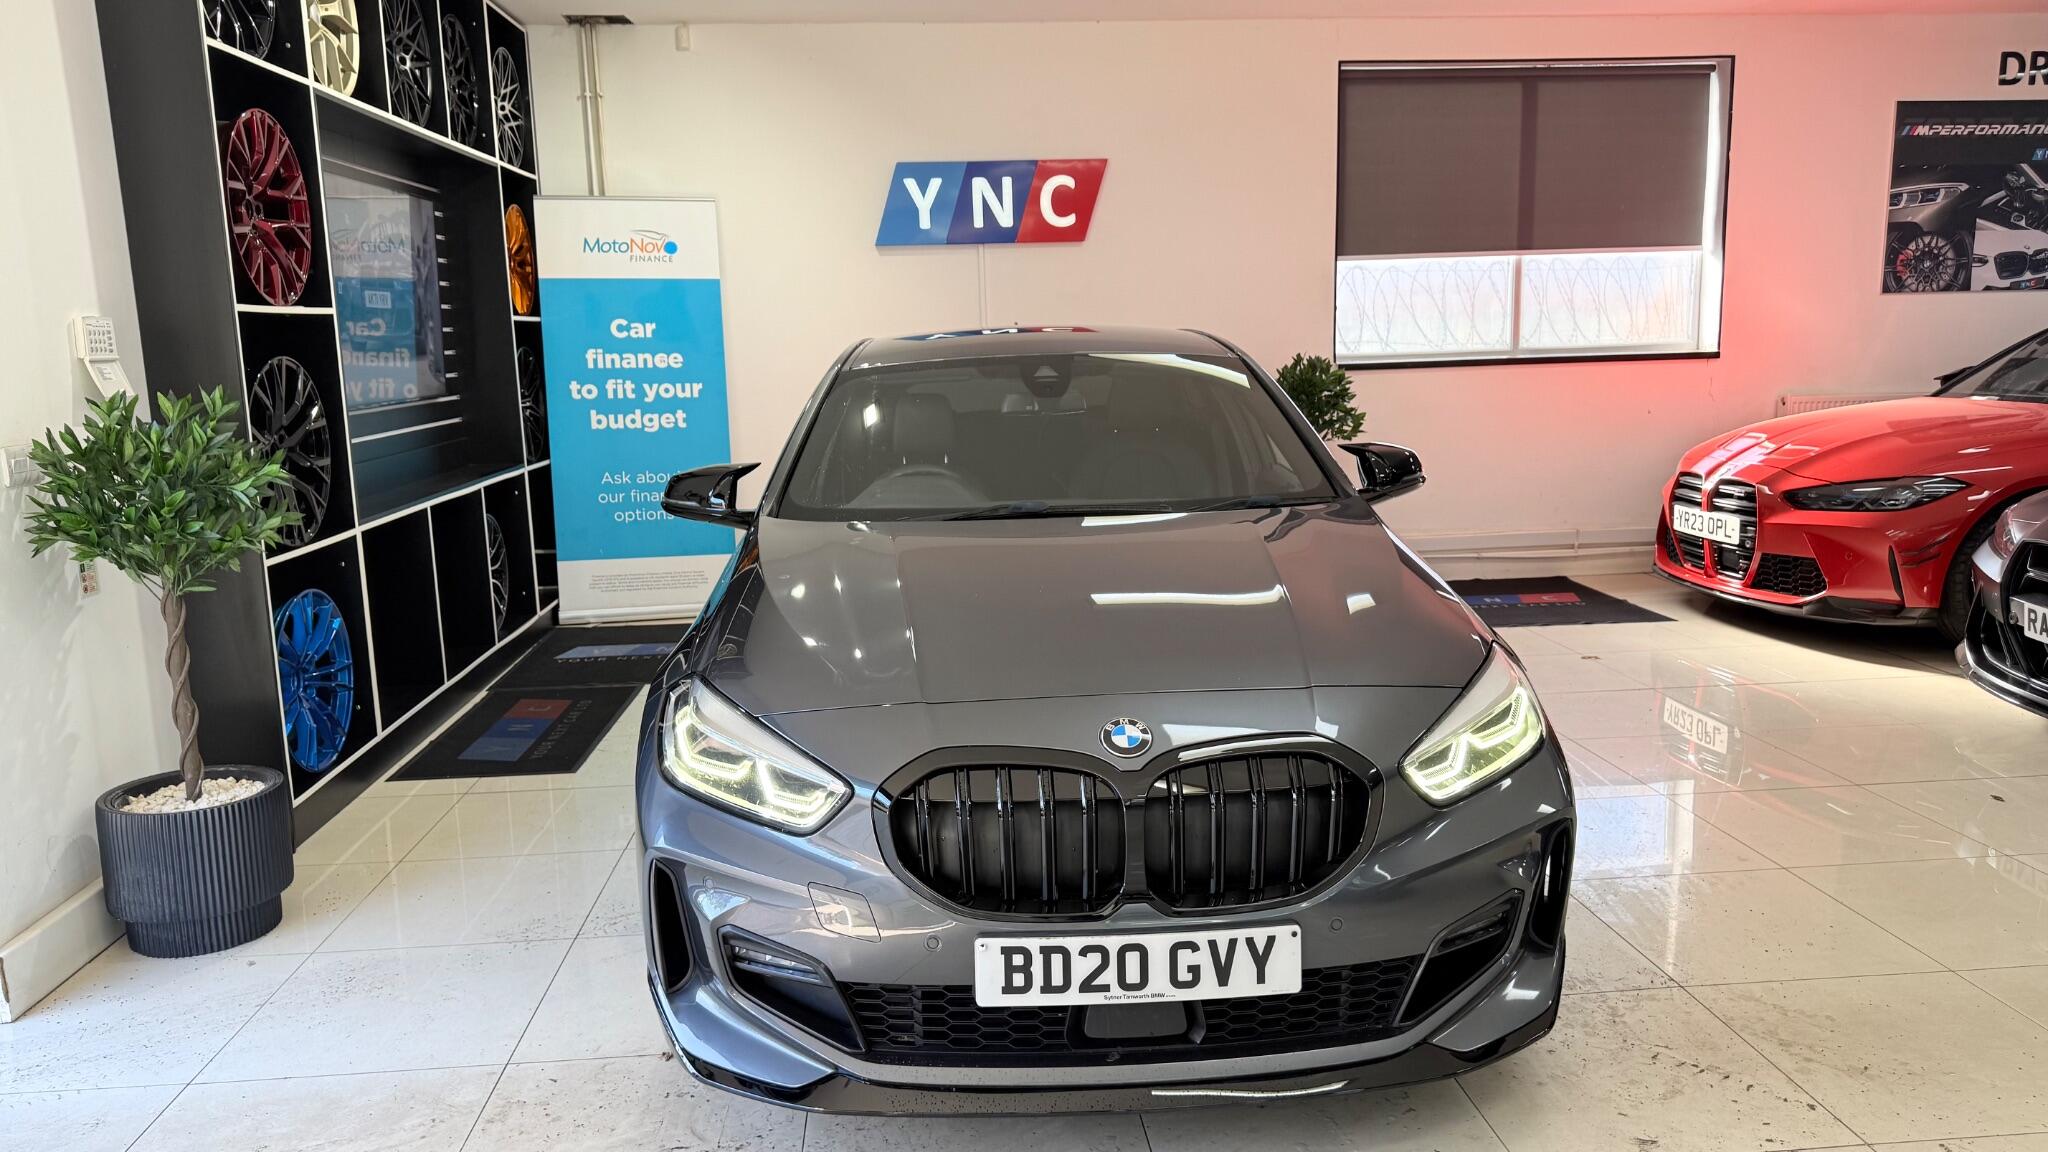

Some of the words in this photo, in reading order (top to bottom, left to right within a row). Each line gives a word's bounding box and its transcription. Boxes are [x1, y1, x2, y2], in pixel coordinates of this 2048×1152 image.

[1998, 51, 2048, 86] DR
[903, 175, 1076, 230] YNC
[630, 255, 673, 263] FINANCE
[610, 318, 656, 338] Car
[585, 348, 683, 369] finance
[569, 381, 598, 400] to
[605, 379, 636, 399] fit
[642, 382, 703, 402] your
[590, 409, 687, 432] budget
[601, 471, 631, 484] Ask
[636, 470, 672, 484] abo
[598, 493, 625, 504] our
[614, 508, 674, 524] options
[1678, 509, 1704, 533] YR23
[1707, 517, 1732, 539] OPL
[1106, 719, 1146, 730] BMW
[1001, 943, 1149, 995] BD20
[1169, 935, 1276, 990] GVY
